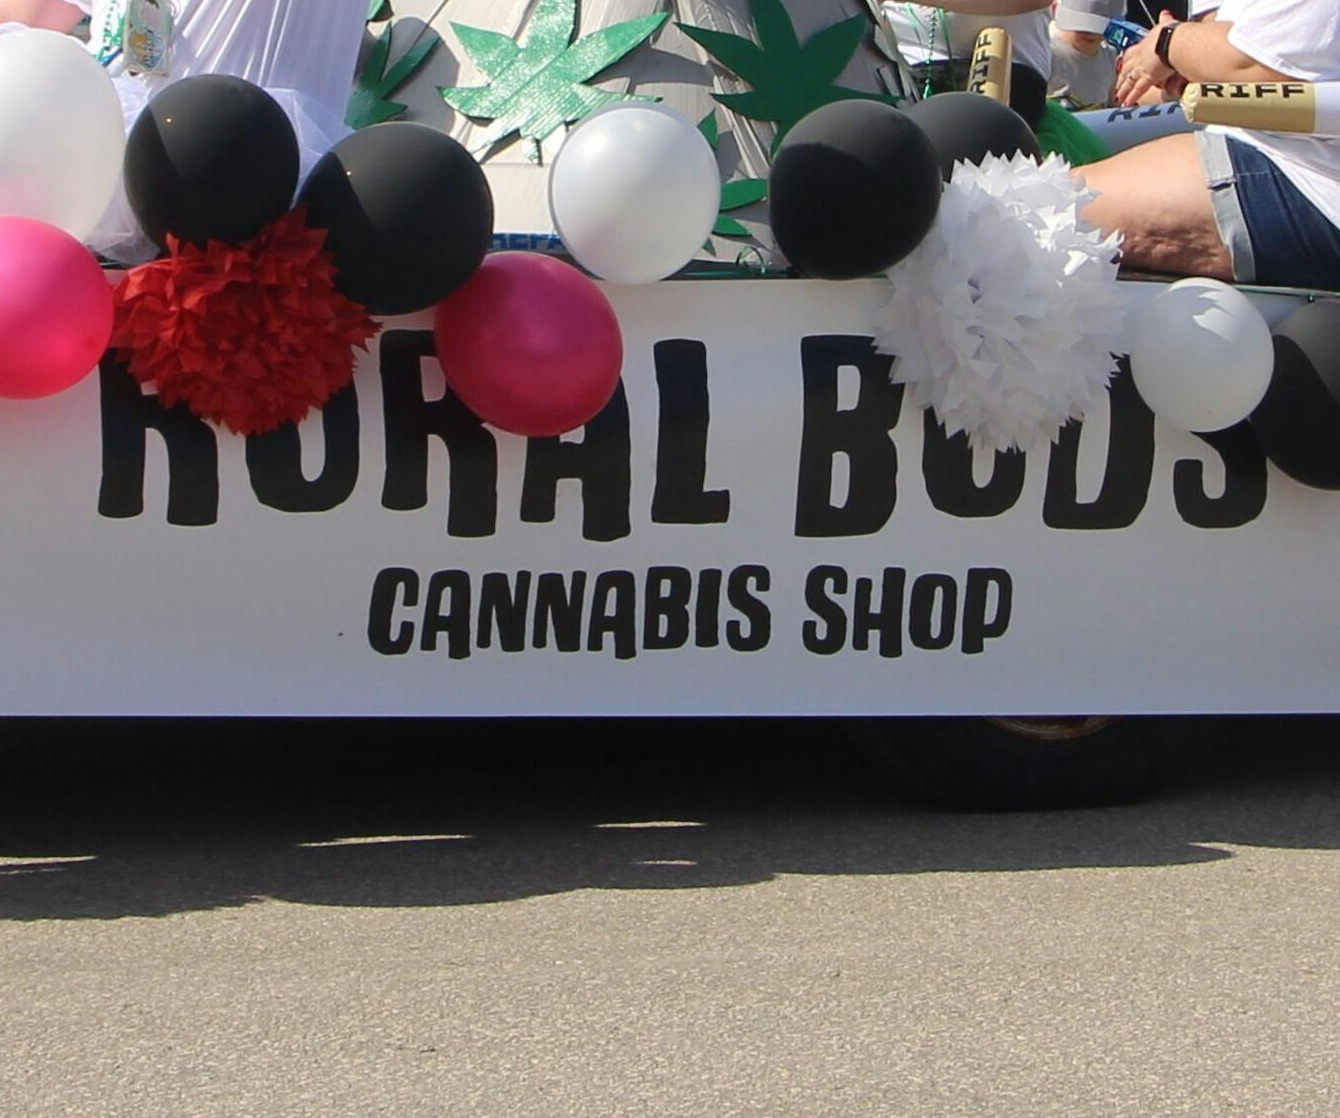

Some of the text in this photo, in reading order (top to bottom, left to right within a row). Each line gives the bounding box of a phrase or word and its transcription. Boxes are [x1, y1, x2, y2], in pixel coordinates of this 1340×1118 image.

[970, 32, 992, 94] RIFF
[1201, 82, 1305, 99] RIFF
[367, 564, 1013, 660] CANNABIS SHOP
